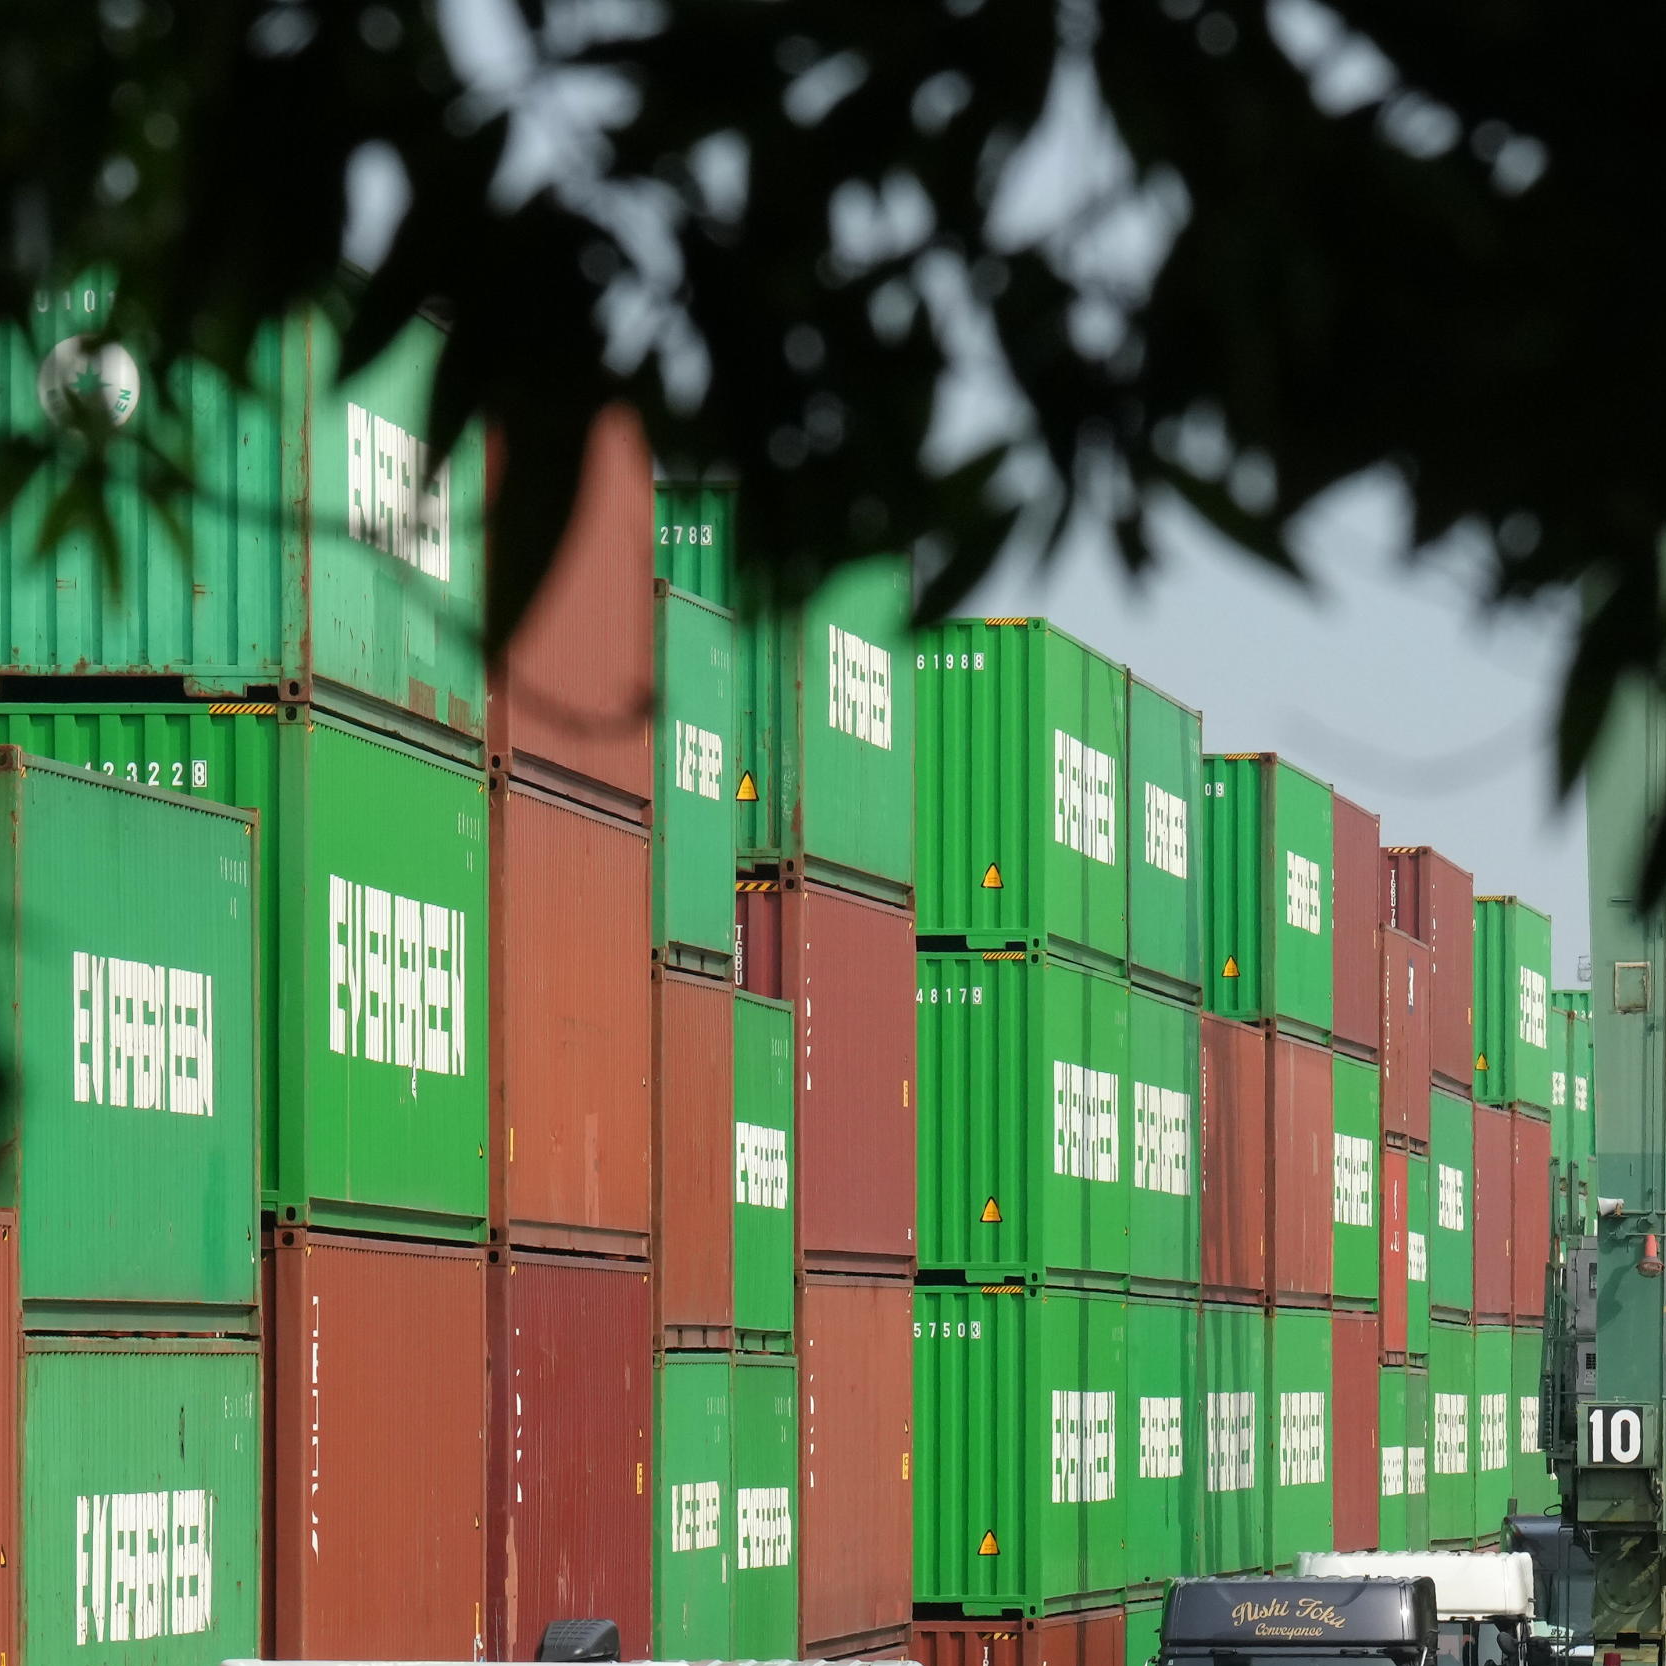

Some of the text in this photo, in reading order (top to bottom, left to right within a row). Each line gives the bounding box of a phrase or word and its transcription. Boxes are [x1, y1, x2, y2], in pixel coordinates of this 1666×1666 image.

[660, 525, 712, 545] 2783
[916, 653, 984, 670] 61988
[1205, 782, 1224, 797] 09
[734, 925, 743, 985] TGBU
[916, 987, 982, 1004] 48179
[913, 1321, 980, 1339] 57503
[1589, 1409, 1641, 1464] 10
[1255, 1622, 1324, 1640] Conveyance
